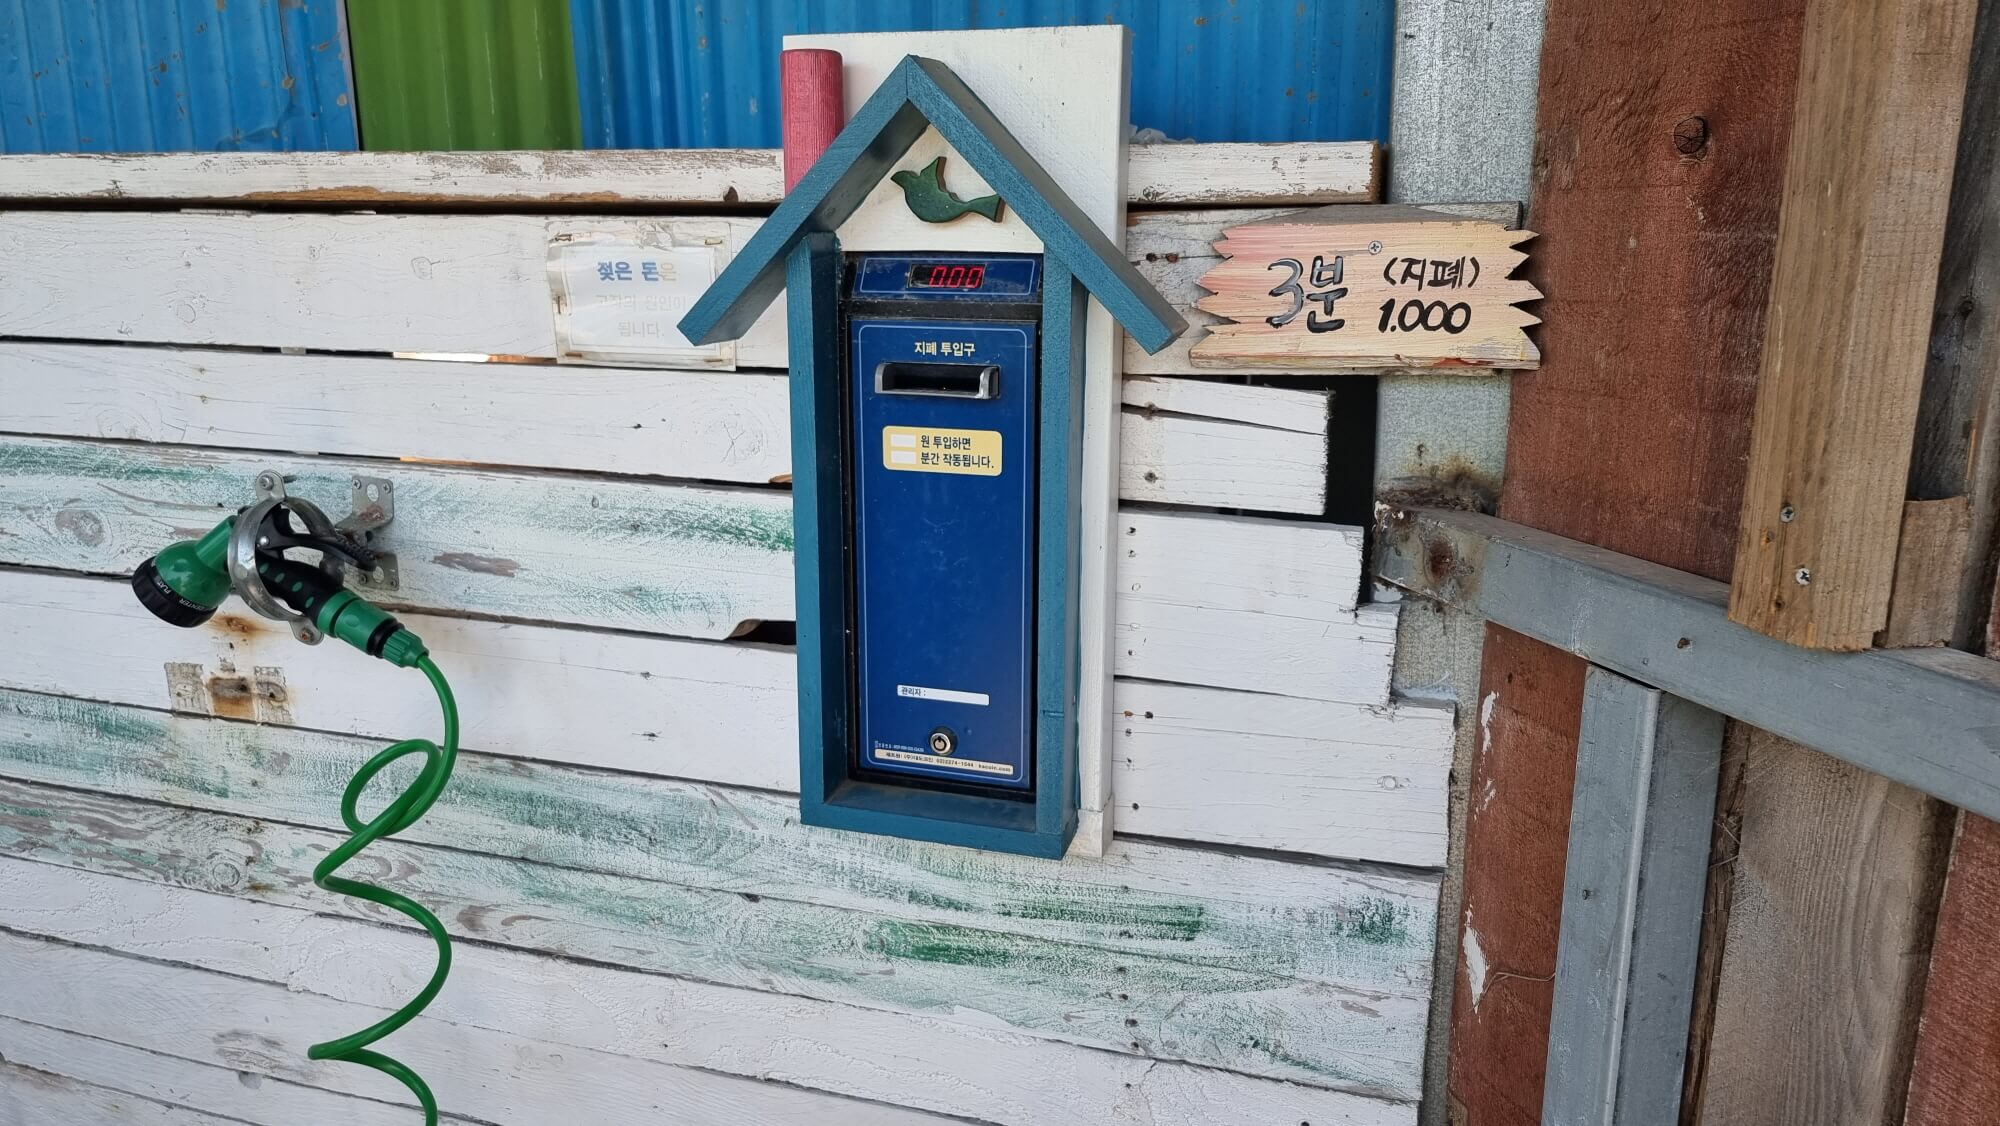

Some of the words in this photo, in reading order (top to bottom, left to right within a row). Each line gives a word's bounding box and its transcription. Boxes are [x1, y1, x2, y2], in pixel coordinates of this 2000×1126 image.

[597, 261, 633, 282] 젖은
[641, 261, 678, 282] 돈은
[1383, 256, 1481, 292] (지폐)
[1265, 254, 1349, 334] 3분
[1377, 298, 1473, 334] 1.000
[617, 320, 666, 339] 됩니다.
[914, 341, 938, 356] 지폐
[939, 342, 977, 358] 투입구
[920, 434, 931, 449] 원
[932, 435, 972, 451] 투입하면
[920, 451, 941, 467] 분간
[942, 453, 995, 470] 작동됩니다.
[901, 686, 922, 697] 관리자
